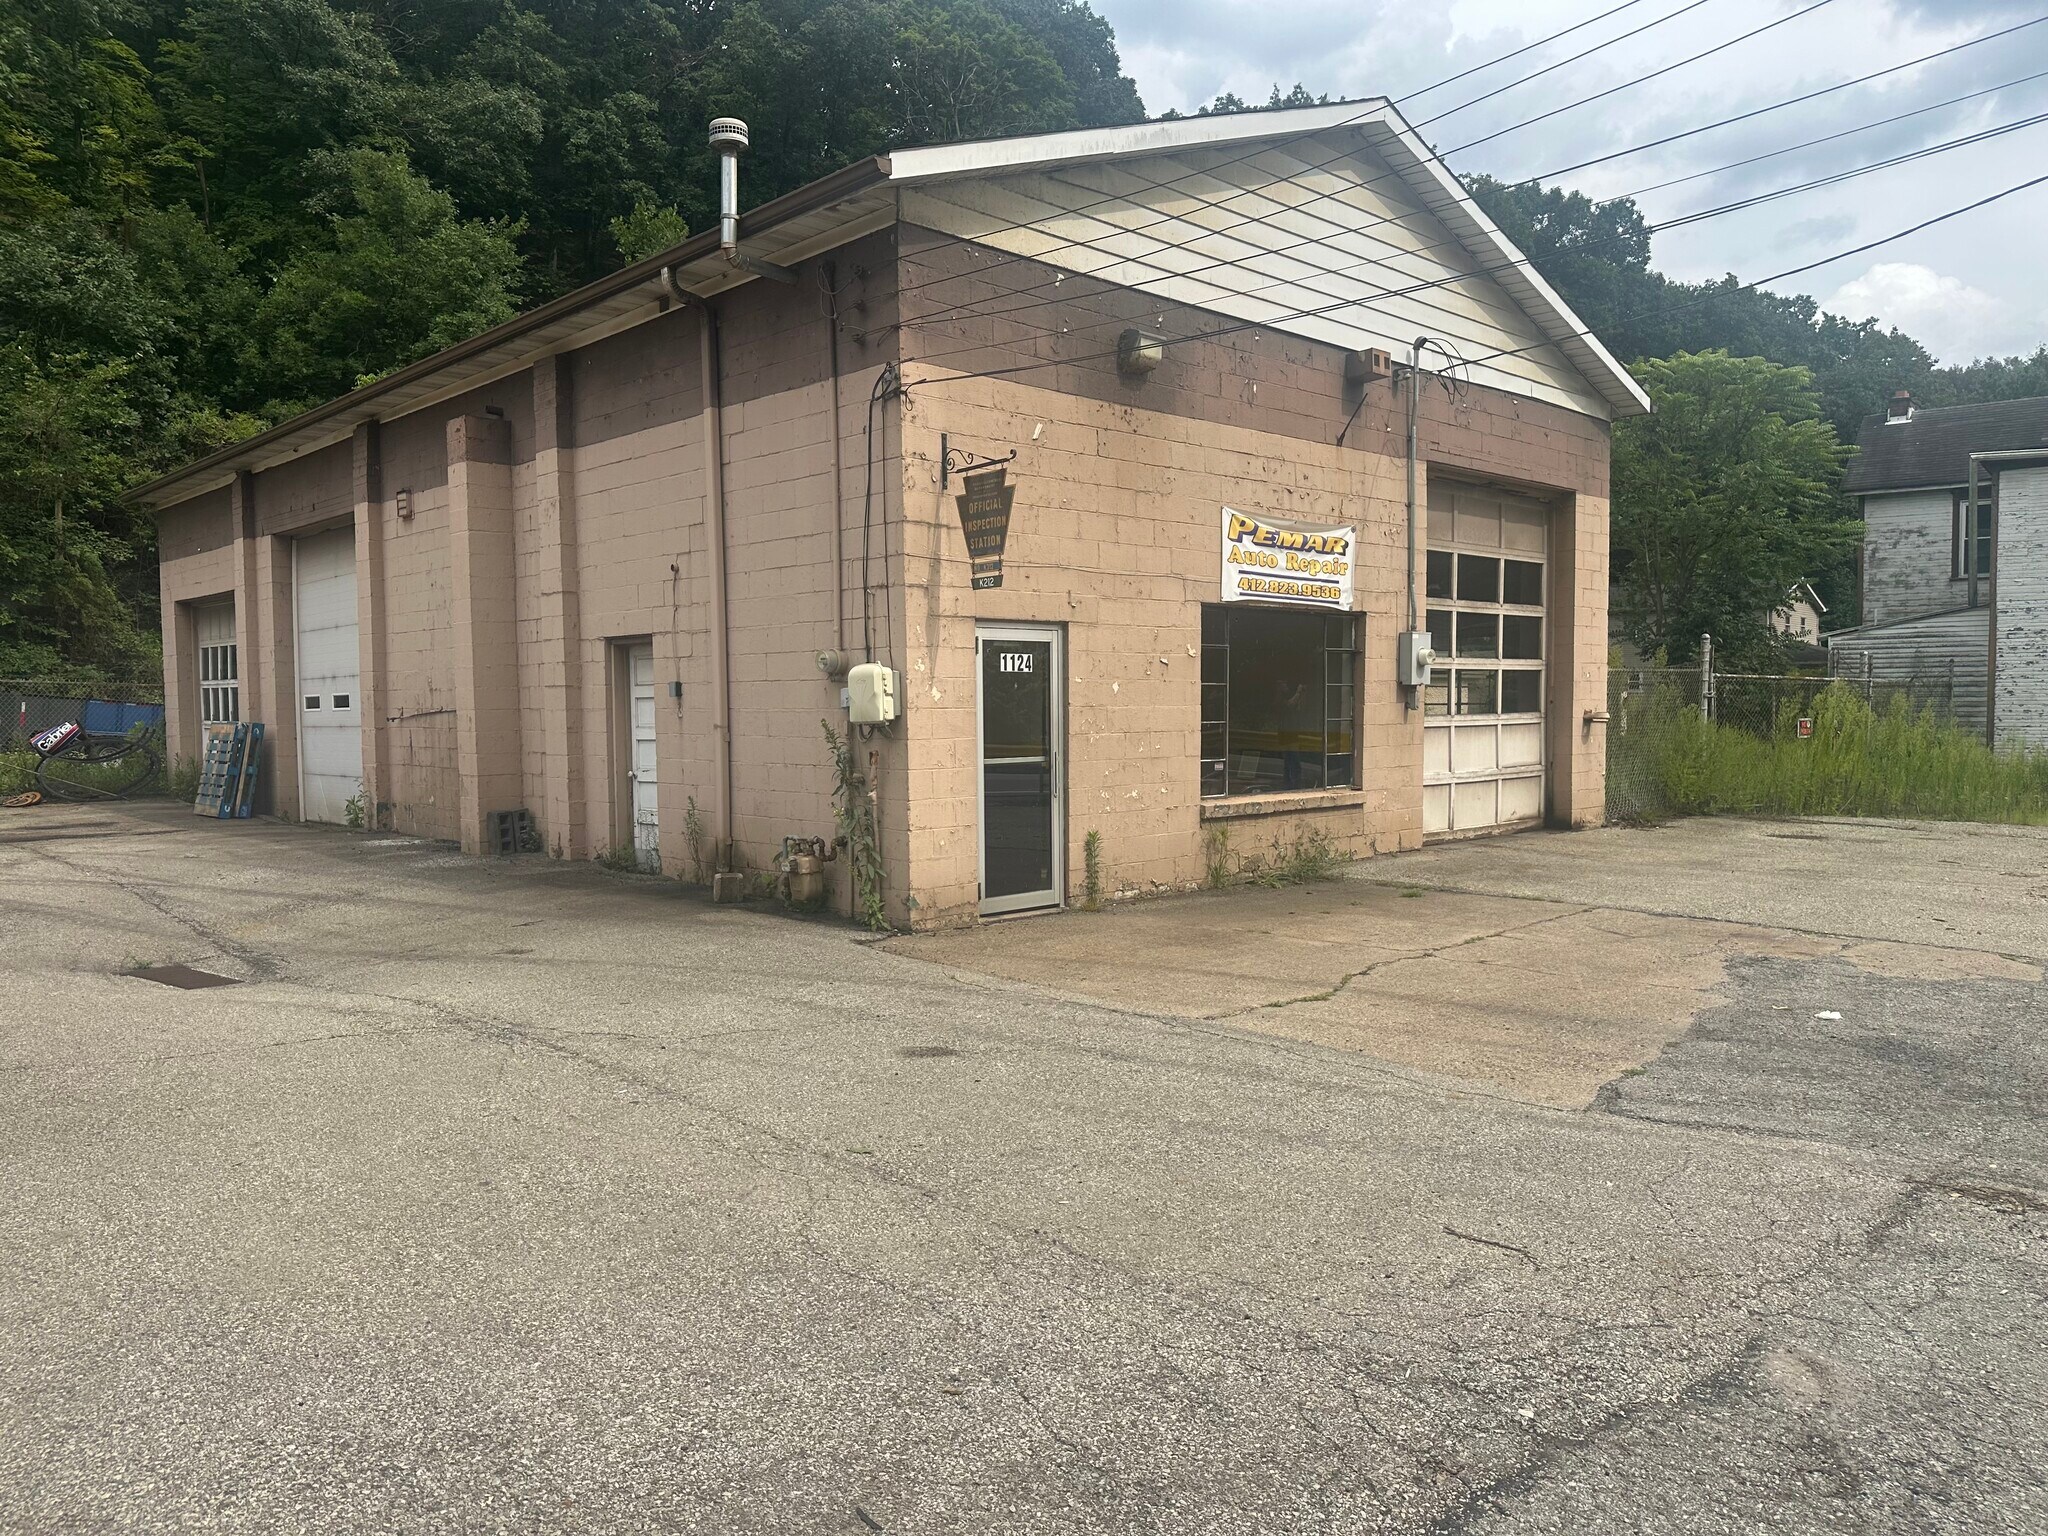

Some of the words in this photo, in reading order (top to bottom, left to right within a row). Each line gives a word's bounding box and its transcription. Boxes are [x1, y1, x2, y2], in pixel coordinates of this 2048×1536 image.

[969, 498, 1002, 514] OFFICIAL
[965, 515, 1006, 532] INSPECTION
[970, 535, 1001, 549] STATION
[1228, 513, 1349, 556] PEMAR
[1227, 545, 1278, 568] Auto
[1286, 552, 1348, 576] Repair
[980, 577, 995, 587] K212
[1238, 577, 1341, 599] 412.823.9536
[1002, 654, 1032, 672] 1124
[37, 721, 73, 751] Gabriel
